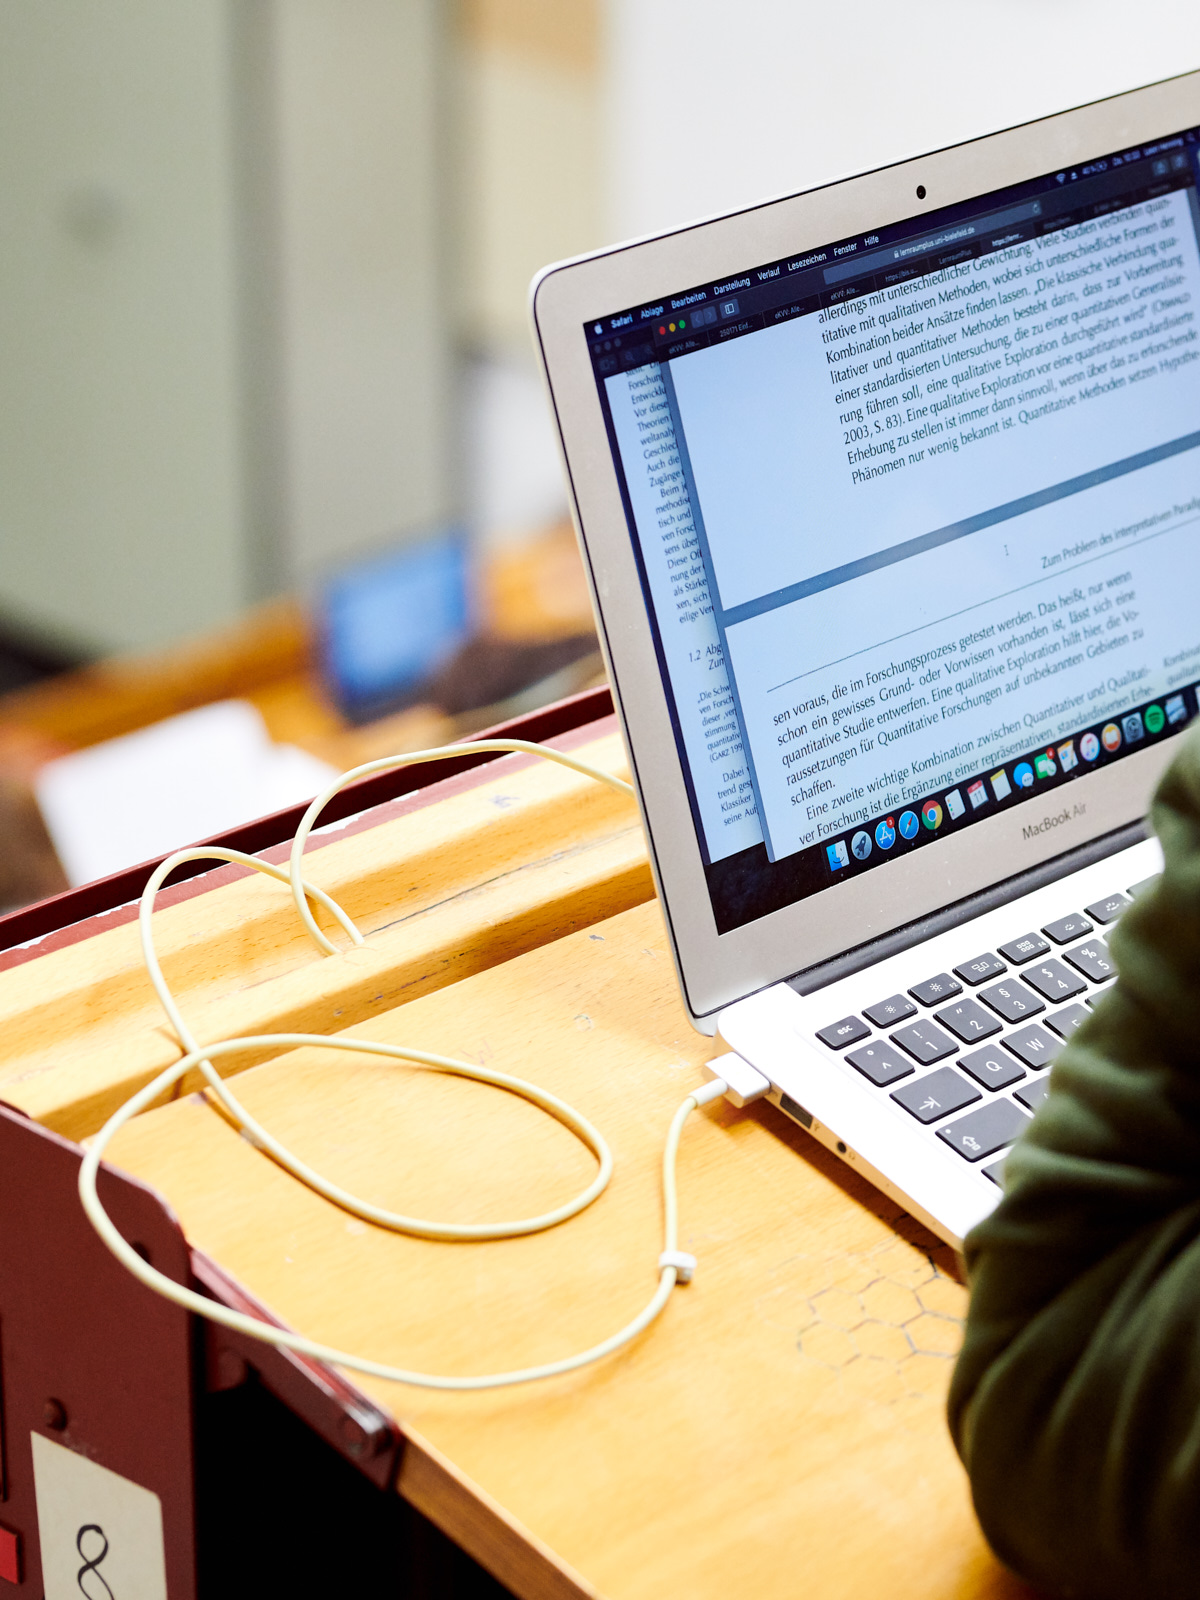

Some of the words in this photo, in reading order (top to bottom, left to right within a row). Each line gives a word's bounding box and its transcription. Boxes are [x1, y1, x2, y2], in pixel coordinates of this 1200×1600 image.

[899, 227, 974, 255] lernraumplus.uni-bielefeld.de
[611, 314, 632, 327] Safari
[641, 306, 662, 318] Ablage
[671, 292, 706, 308] Bearbeiten
[713, 278, 750, 294] Darstellung
[757, 266, 779, 279] Verlauf
[787, 253, 826, 270] Lesezeichen
[833, 243, 856, 255] Fenster
[864, 235, 878, 245] Hilfe
[818, 297, 868, 324] allerdings
[869, 289, 886, 307] mit
[887, 262, 971, 301] unterschiedlicher
[972, 242, 1034, 272] Gewichtung.
[1034, 232, 1060, 250] Viele
[821, 324, 857, 344] titative
[859, 315, 877, 332] mit
[878, 298, 937, 329] qualitativen
[938, 280, 991, 305] Methoden,
[992, 265, 1023, 286] wobei
[1024, 258, 1045, 276] sich
[826, 334, 892, 365] Kombination
[891, 321, 924, 342] beider
[927, 309, 965, 330] Ansätze
[965, 297, 998, 317] finden
[997, 287, 1031, 305] lassen.
[1034, 277, 1056, 297] „Die
[830, 363, 869, 385] litativer
[872, 350, 893, 370] und
[896, 332, 957, 365] quantitativer
[961, 314, 1011, 339] Methoden
[1012, 300, 1048, 321] besteht
[1051, 291, 1079, 308] darin,
[835, 387, 861, 405] einer
[862, 360, 941, 395] standardisierten
[941, 335, 1013, 367] Untersuchung,
[1014, 327, 1030, 342] die
[1031, 324, 1044, 336] zu
[1045, 314, 1069, 331] einer
[839, 408, 864, 425] rung
[866, 396, 899, 416] führen
[902, 384, 923, 403] soll,
[926, 378, 949, 394] eine
[951, 359, 1002, 389] qualitative
[1004, 339, 1059, 367] Exploration
[843, 425, 873, 446] 2003,
[873, 420, 885, 434] S.
[885, 413, 906, 430] 83).
[906, 406, 929, 423] Eine
[929, 388, 981, 417] qualitative
[981, 368, 1036, 396] Exploration
[1036, 362, 1052, 375] vor
[1053, 355, 1074, 370] eine
[637, 411, 670, 431] Theorien
[847, 439, 897, 465] Erhebung
[897, 434, 910, 448] zu
[911, 422, 944, 442] stellen
[945, 416, 957, 430] ist
[958, 406, 989, 425] immer
[991, 396, 1016, 413] dann
[1017, 378, 1058, 404] sinnvoll,
[1058, 371, 1086, 388] wenn
[852, 457, 906, 485] Phänomen
[908, 450, 925, 465] nur
[927, 437, 960, 457] wenig
[960, 421, 1000, 446] bekannt
[1001, 417, 1016, 430] ist.
[1018, 395, 1077, 425] Quantitative
[646, 458, 666, 472] Auch
[667, 452, 681, 465] die
[649, 469, 681, 487] Zugänge
[659, 485, 680, 498] Beim
[676, 508, 692, 521] und
[681, 534, 699, 549] über
[666, 555, 688, 569] Diese
[1041, 554, 1062, 570] Zum
[688, 648, 701, 662] 1.2
[773, 710, 791, 727] sen
[792, 694, 829, 717] voraus,
[832, 684, 849, 701] die
[850, 679, 865, 693] im
[866, 642, 957, 687] Forschungsprozess
[959, 625, 996, 653] getestet
[997, 611, 1037, 633] werden.
[1037, 601, 1058, 617] Das
[1058, 588, 1087, 609] heißt,
[777, 724, 808, 747] schon
[811, 715, 828, 731] ein
[832, 696, 876, 726] gewisses
[879, 676, 915, 702] Grund-
[919, 668, 941, 686] oder
[944, 648, 995, 675] Vorwissen
[997, 626, 1049, 653] vorhanden
[1052, 618, 1066, 632] ist,
[1068, 607, 1091, 625] lässt
[782, 732, 841, 769] quantitative
[842, 717, 875, 740] Studie
[876, 697, 930, 725] entwerfen.
[931, 686, 953, 703] Eine
[955, 664, 1006, 696] qualitative
[1006, 642, 1062, 672] Exploration
[1061, 630, 1082, 649] hilft
[1082, 624, 1105, 640] hier,
[786, 747, 858, 787] raussetzungen
[859, 738, 874, 754] für
[877, 713, 939, 747] Quantitative
[941, 687, 1003, 720] Forschungen
[1005, 675, 1020, 694] auf
[1023, 653, 1085, 686] unbekannten
[806, 803, 829, 821] Eine
[831, 787, 865, 810] zweite
[866, 768, 910, 794] wichtige
[911, 741, 975, 775] Kombination
[977, 721, 1022, 748] zwischen
[1023, 694, 1085, 729] Quantitativer
[1087, 681, 1106, 701] und
[721, 765, 745, 782] Dabei
[716, 782, 737, 799] trend
[790, 779, 836, 806] schaffen.
[799, 830, 815, 845] ver
[816, 807, 870, 838] Forschung
[870, 799, 883, 814] ist
[883, 793, 901, 808] die
[901, 771, 955, 801] Ergänzung
[954, 759, 979, 778] einer
[981, 729, 1056, 767] repräsentativen,
[720, 793, 751, 812] Klassiker
[723, 812, 742, 826] seine
[1022, 812, 1071, 839] MacBook
[1071, 804, 1086, 819] Air
[1081, 949, 1097, 958] %
[1042, 969, 1053, 977] $
[1098, 960, 1109, 970] 5
[1058, 980, 1068, 988] 4
[1013, 1001, 1026, 1010] 3
[834, 1024, 852, 1035] esc
[970, 1020, 983, 1030] 2
[926, 1042, 938, 1050] 1
[1026, 1039, 1044, 1051] W
[986, 1061, 1002, 1071] Q
[76, 1523, 115, 1600] 8
